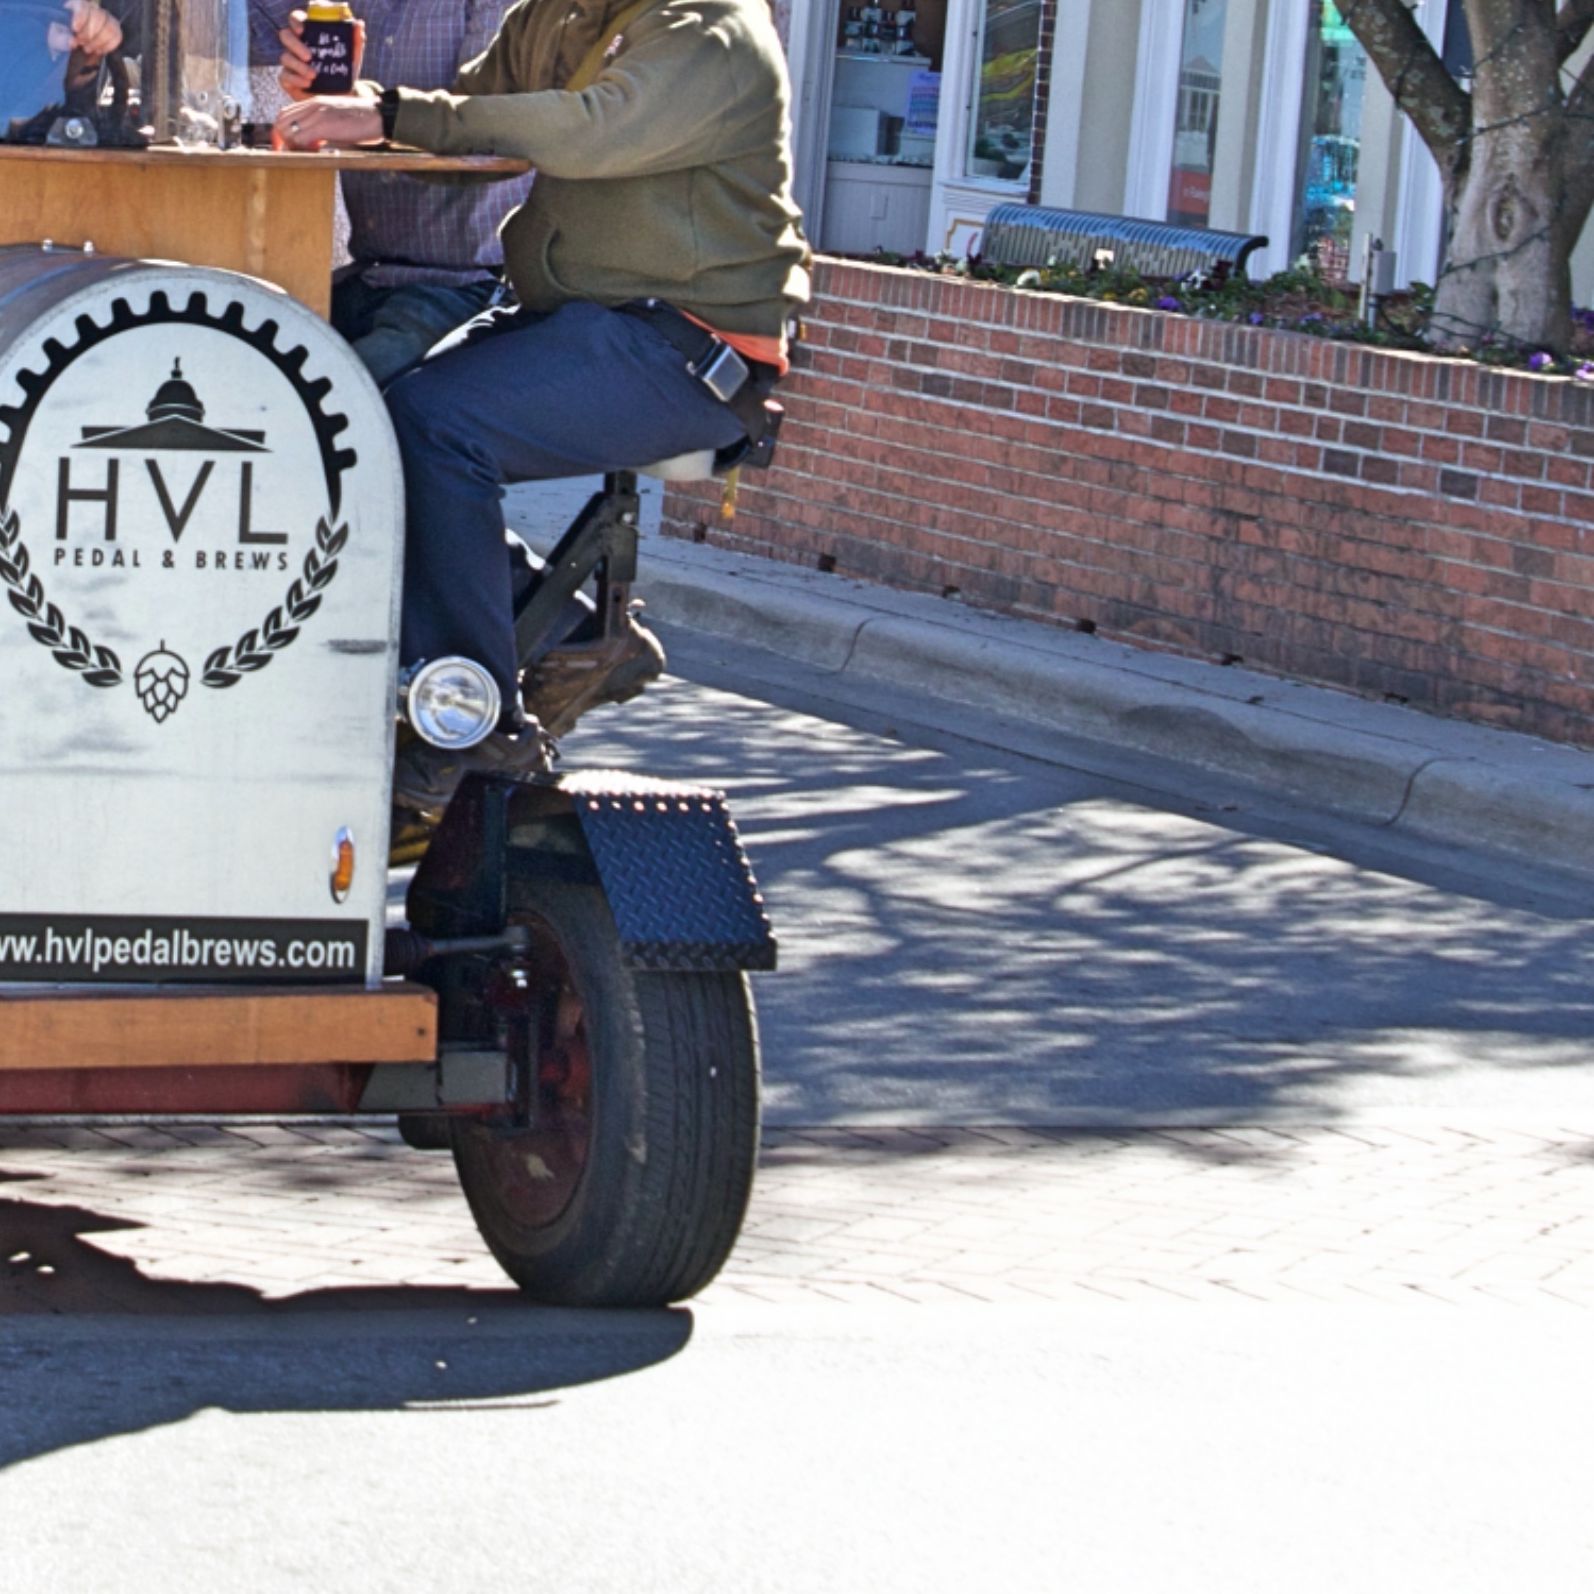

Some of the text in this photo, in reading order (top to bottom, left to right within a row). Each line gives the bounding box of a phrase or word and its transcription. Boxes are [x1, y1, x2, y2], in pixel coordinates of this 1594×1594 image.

[56, 457, 288, 545] HVL
[54, 547, 288, 571] PEDAL & BREWS
